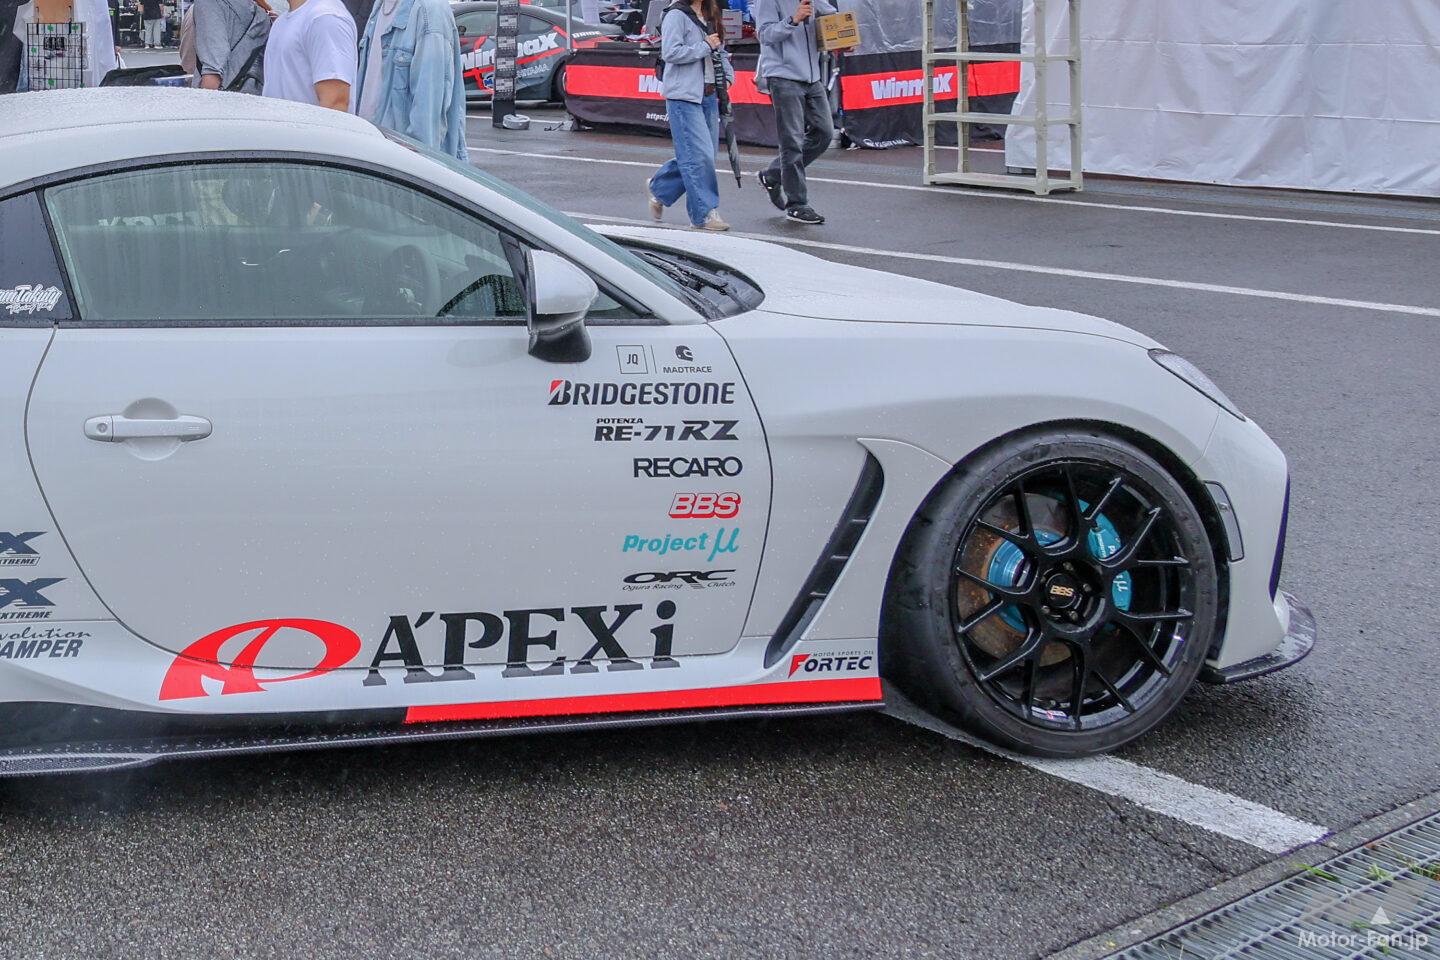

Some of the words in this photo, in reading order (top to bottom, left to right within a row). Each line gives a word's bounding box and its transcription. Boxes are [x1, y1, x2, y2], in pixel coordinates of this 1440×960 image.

[626, 353, 639, 365] JQ
[663, 366, 712, 374] MADTRACE
[548, 380, 735, 406] BRIDGESTONE
[594, 420, 739, 442] RE-71RZ
[596, 417, 644, 425] POTENZA
[633, 456, 743, 478] RECARO
[668, 492, 742, 519] BBS
[622, 532, 709, 555] Project
[623, 569, 736, 584] ORC
[788, 653, 872, 679] FORTEC
